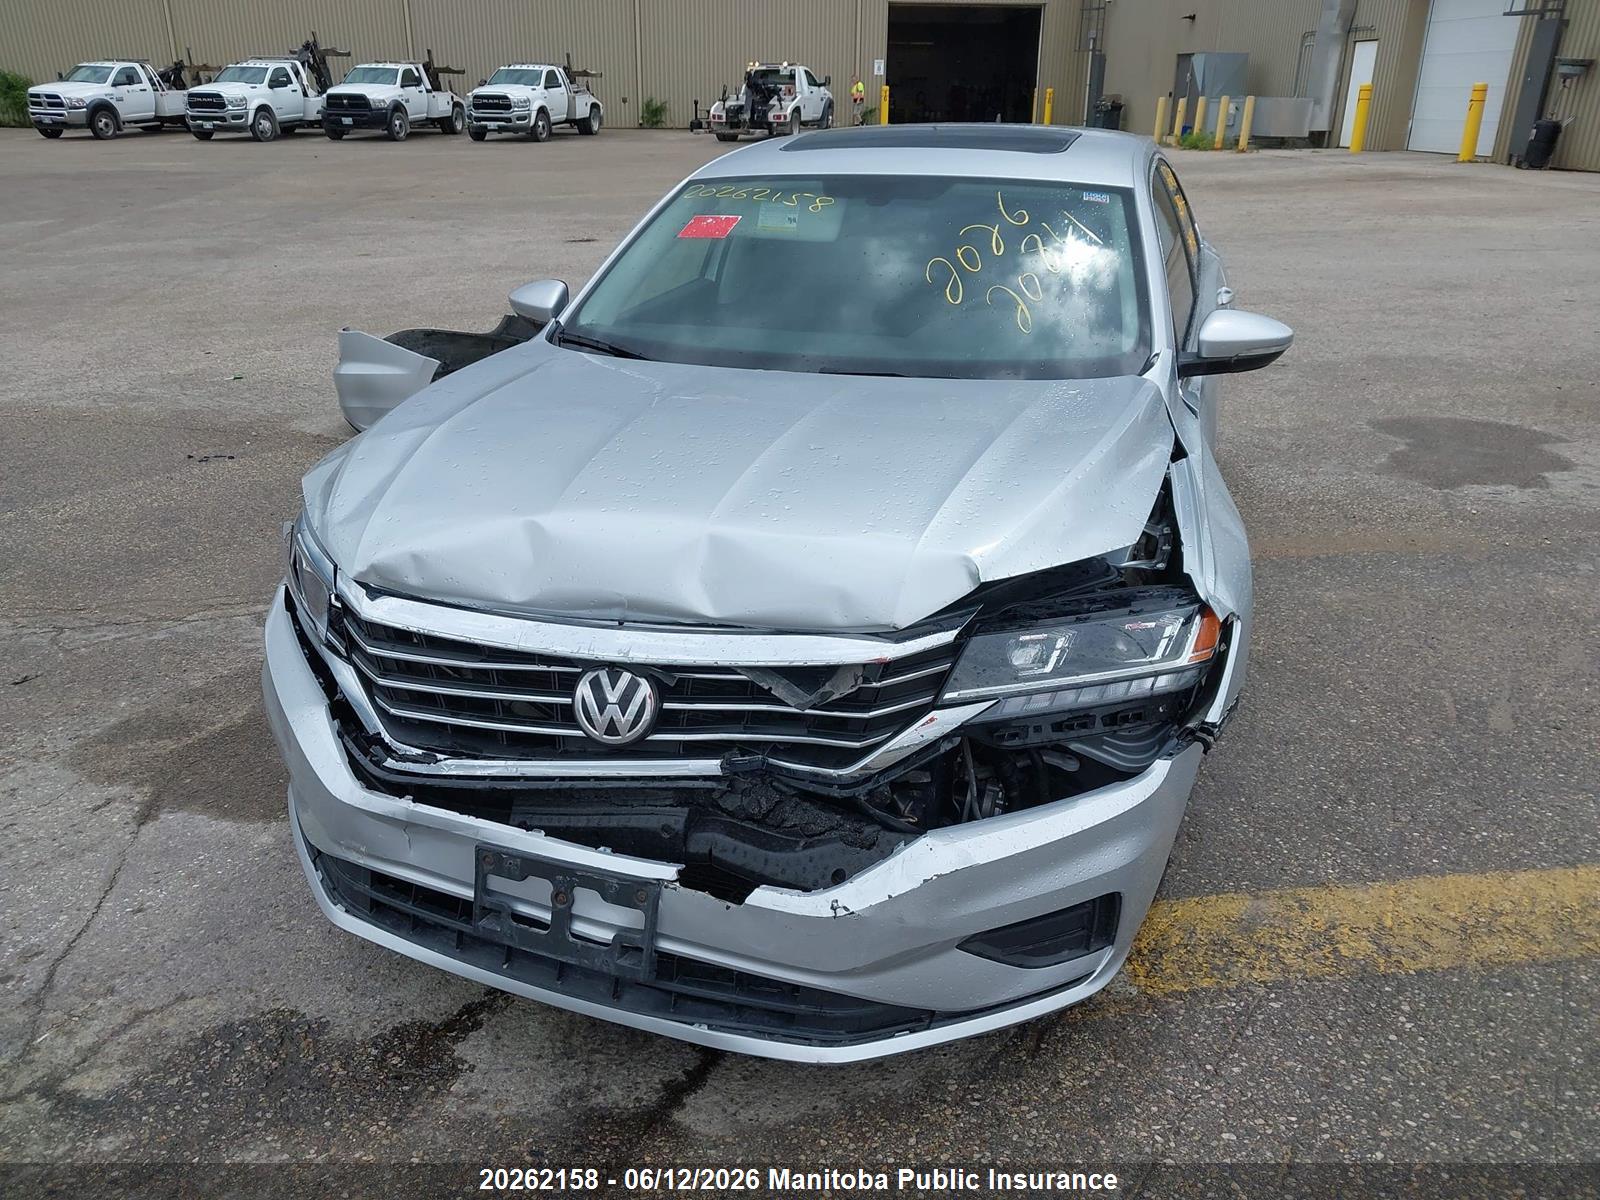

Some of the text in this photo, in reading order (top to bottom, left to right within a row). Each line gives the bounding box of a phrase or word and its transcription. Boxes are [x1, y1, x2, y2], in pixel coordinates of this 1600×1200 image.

[683, 183, 835, 213] 20262158
[925, 191, 1030, 305] 2026
[577, 668, 652, 742] VW
